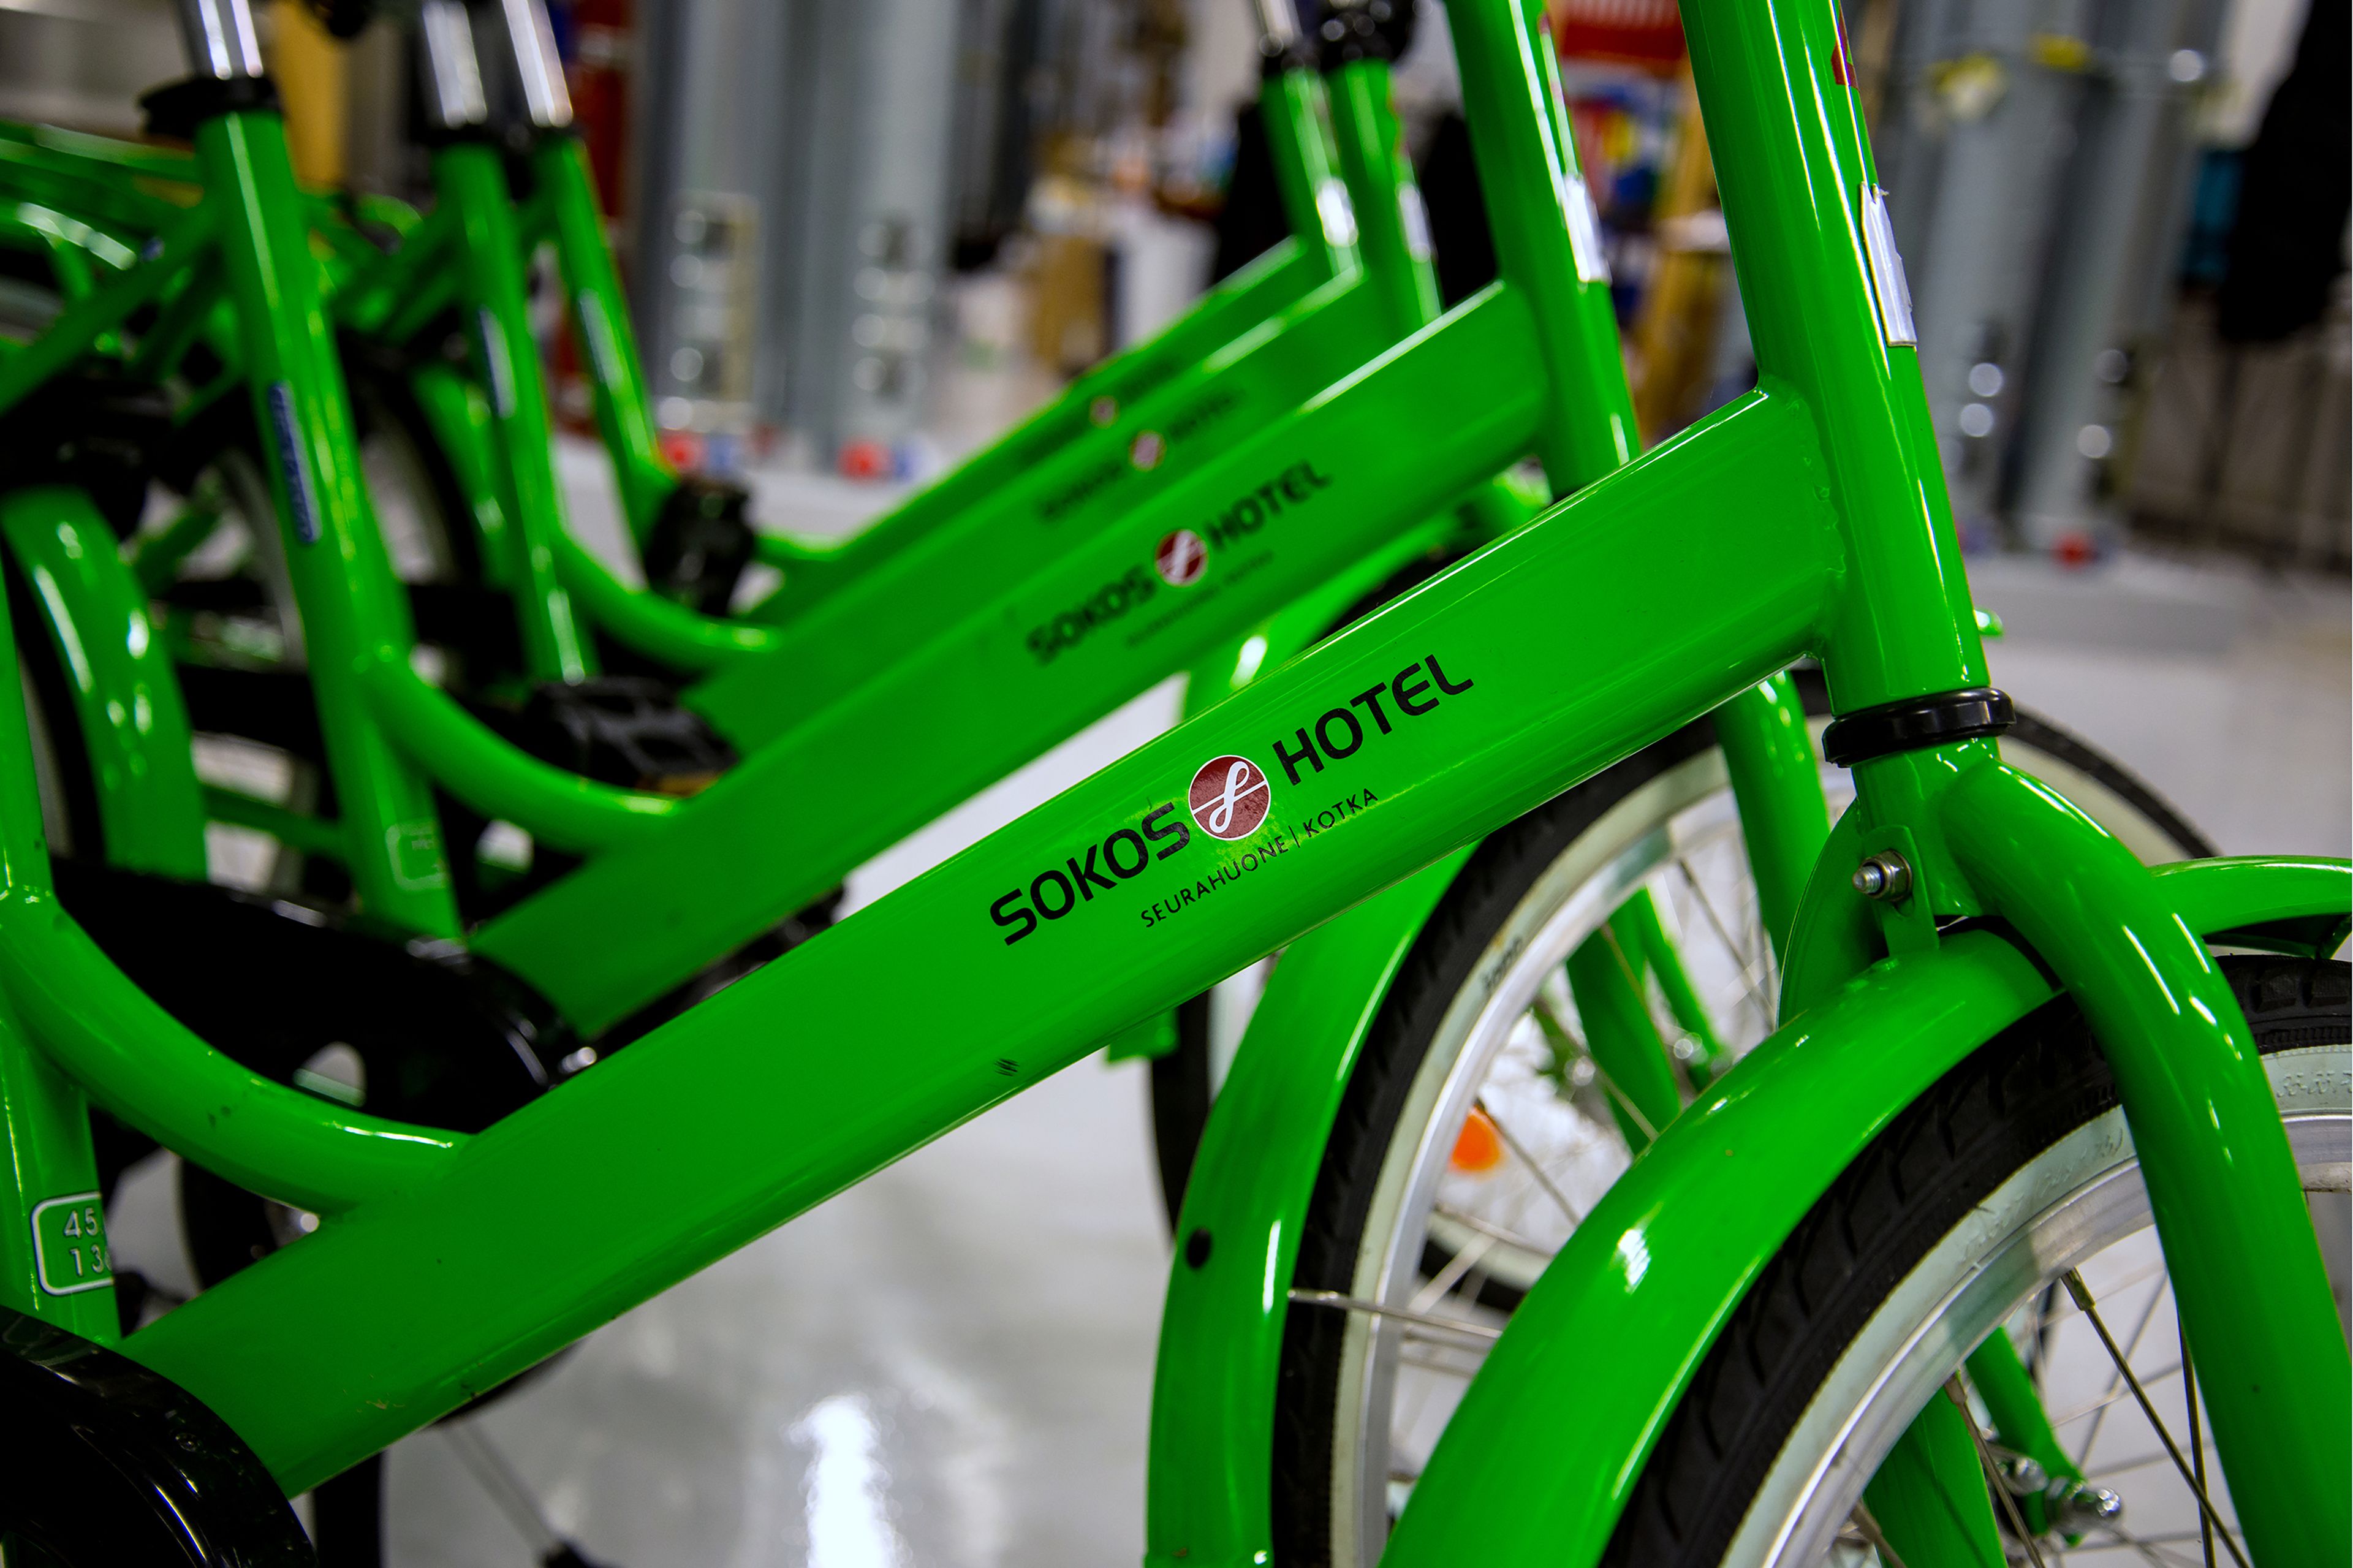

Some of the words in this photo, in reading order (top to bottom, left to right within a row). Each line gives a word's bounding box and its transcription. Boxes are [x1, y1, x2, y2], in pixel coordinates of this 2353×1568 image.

[1205, 461, 1332, 550] HOTEL
[989, 801, 1191, 946] SOKOS
[1271, 654, 1474, 786] HOTEL
[1140, 835, 1289, 928] SEURAHUONE
[1302, 787, 1379, 838] KOTKA
